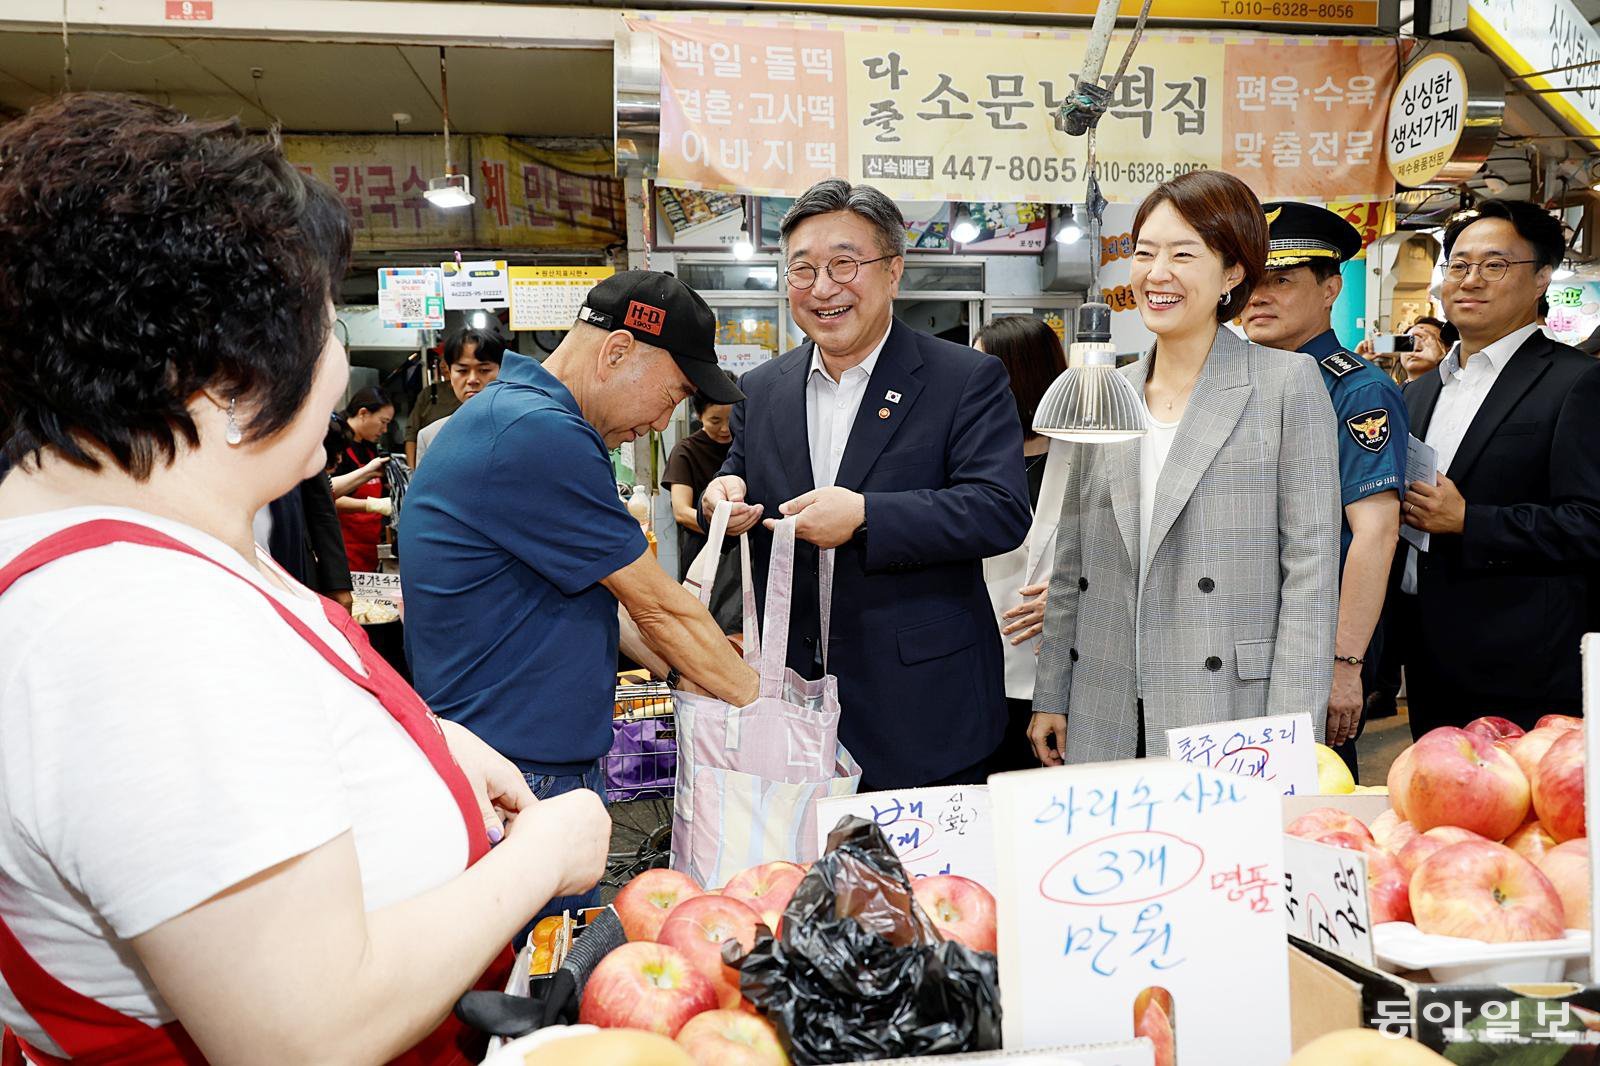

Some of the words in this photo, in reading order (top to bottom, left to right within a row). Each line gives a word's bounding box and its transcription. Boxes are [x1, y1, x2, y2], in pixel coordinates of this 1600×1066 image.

[1221, 0, 1354, 18] T.010-6328-8056
[1400, 70, 1453, 116] 싱싱한
[1234, 130, 1374, 168] 맞춤전문
[1390, 103, 1459, 154] 생선가게
[866, 158, 930, 178] 신속배달
[631, 304, 661, 324] H-D
[1073, 845, 1167, 896] 3개
[1210, 864, 1279, 914] 명품
